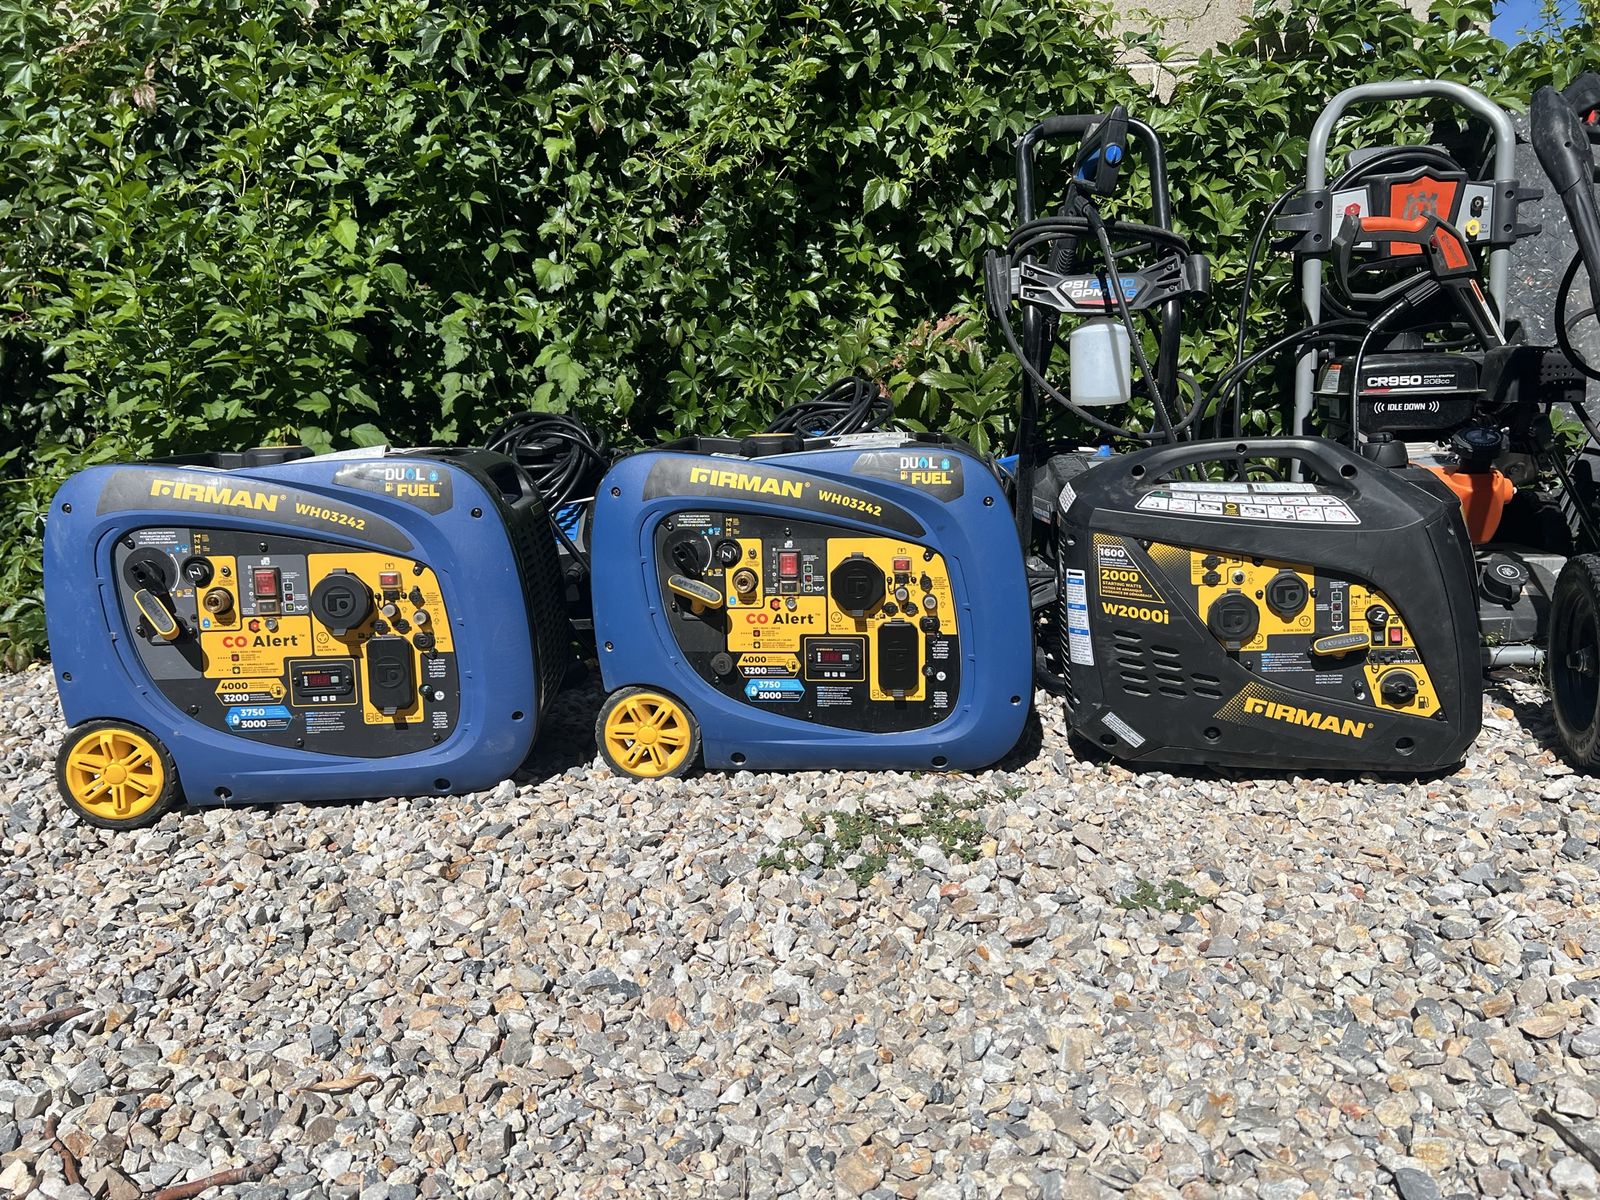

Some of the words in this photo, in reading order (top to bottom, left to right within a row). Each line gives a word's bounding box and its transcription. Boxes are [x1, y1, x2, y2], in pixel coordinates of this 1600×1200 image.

[1060, 280, 1088, 290] PSI
[1367, 375, 1422, 387] CR950
[1387, 403, 1402, 411] IDLE
[1403, 403, 1426, 411] DOWN
[900, 456, 938, 469] DUAL
[385, 468, 425, 481] DUAL
[911, 472, 952, 485] FUEL
[397, 483, 440, 497] FUEL
[689, 467, 804, 499] FIRMAN
[818, 490, 883, 516] WH03242
[150, 479, 278, 512] FIRMAN
[295, 503, 366, 531] WH03242
[1099, 548, 1125, 558] 1600
[1101, 570, 1139, 582] 2000
[746, 613, 769, 624] CO
[772, 613, 814, 625] Alert
[1102, 602, 1169, 625] W2000i
[222, 636, 248, 649] CO
[252, 635, 298, 648] Alert
[744, 666, 768, 675] 3200
[221, 682, 249, 690] 4000
[758, 681, 781, 689] 3750
[223, 693, 249, 703] 3200
[758, 691, 782, 699] 3000
[240, 708, 265, 717] 3750
[1243, 696, 1366, 739] FIRMAN
[241, 719, 267, 729] 3000
